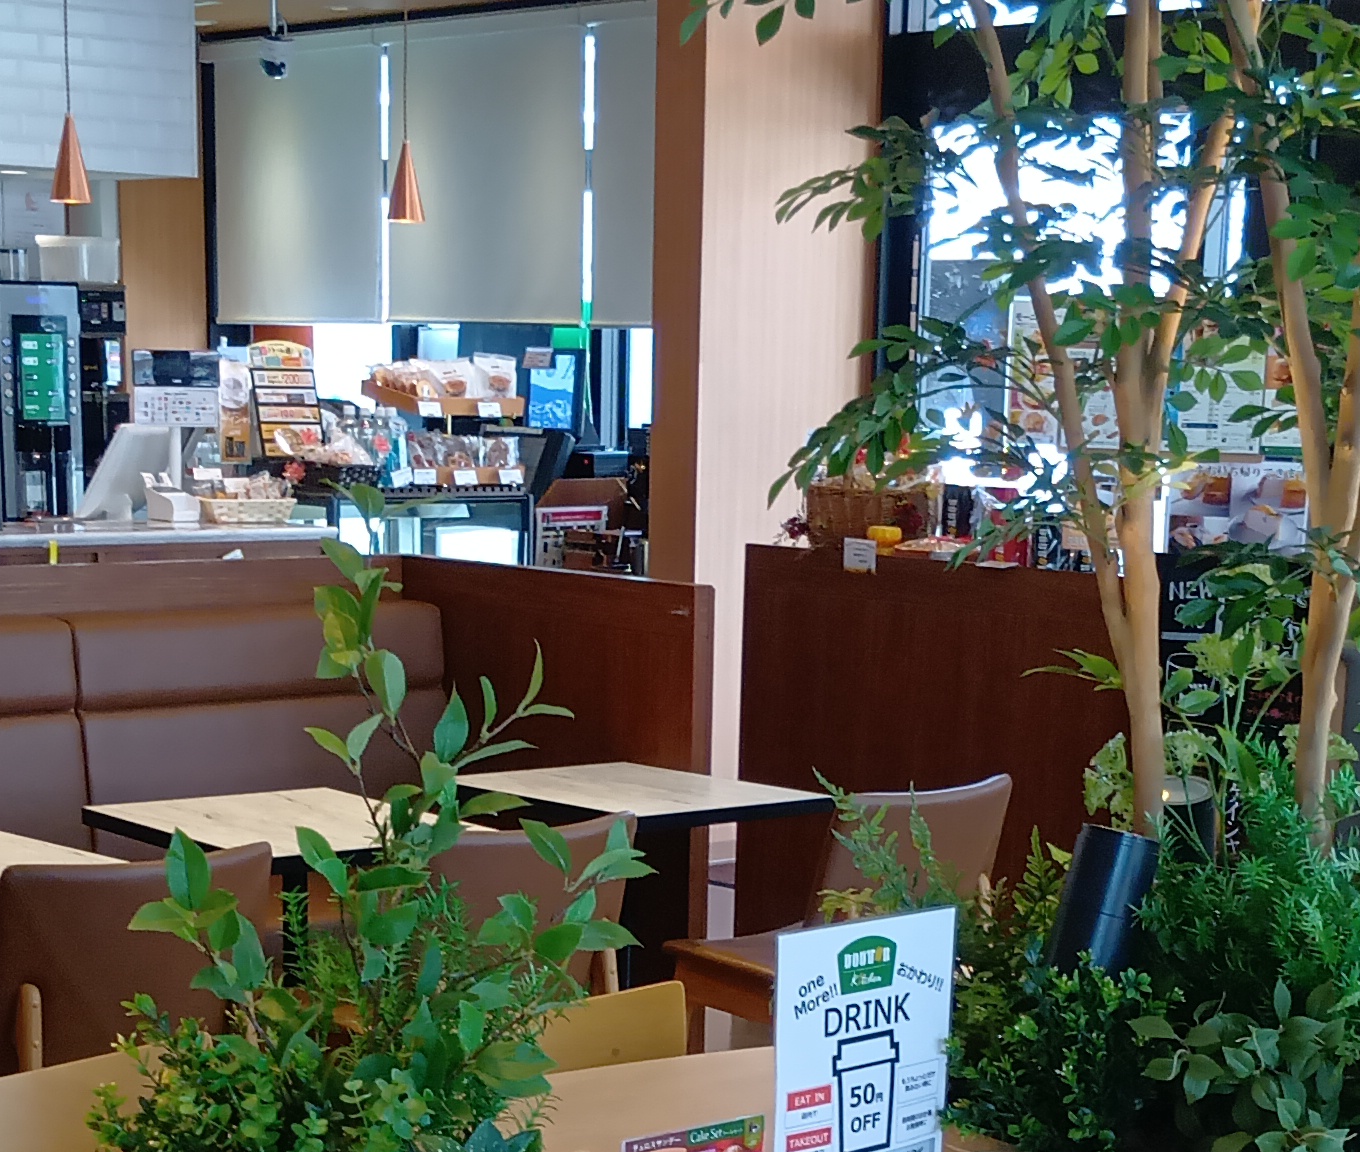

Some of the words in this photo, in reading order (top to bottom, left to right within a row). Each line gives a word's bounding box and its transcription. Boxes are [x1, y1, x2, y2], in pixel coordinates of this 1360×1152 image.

[797, 974, 826, 998] one
[793, 983, 840, 1020] More!!
[824, 991, 911, 1038] DRINK
[794, 1094, 812, 1107] EAT
[814, 1092, 826, 1103] IN
[849, 1082, 884, 1109] 50円
[850, 1111, 882, 1134] OFF
[788, 1132, 829, 1150] TAKEOUT
